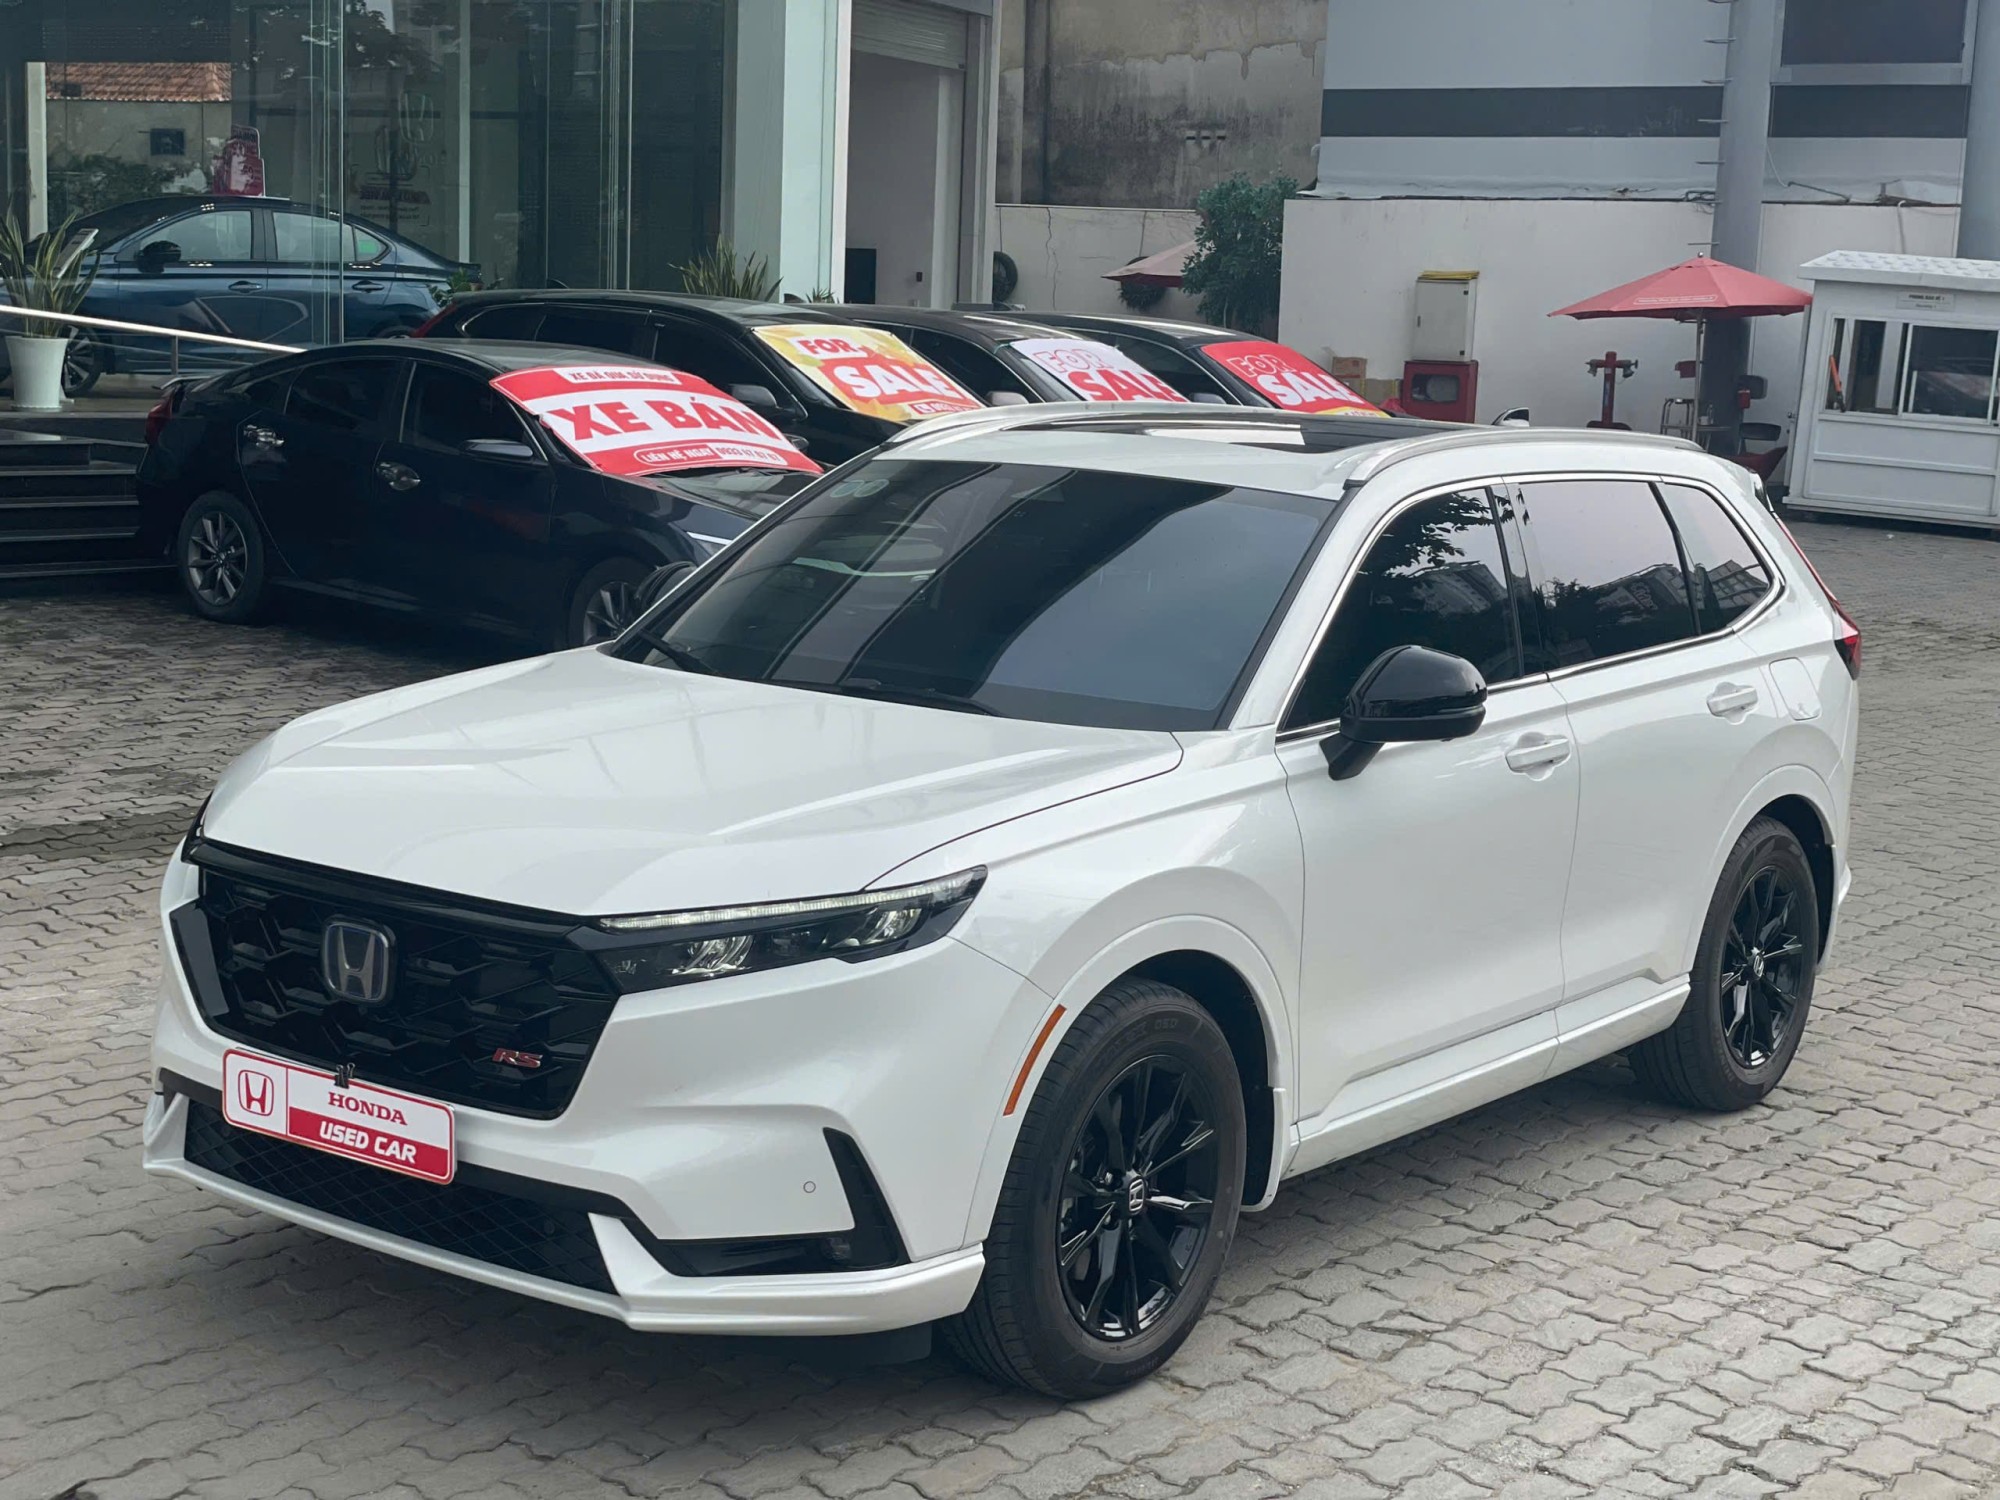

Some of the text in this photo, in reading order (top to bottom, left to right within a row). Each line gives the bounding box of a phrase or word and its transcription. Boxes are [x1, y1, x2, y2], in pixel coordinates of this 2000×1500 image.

[798, 338, 857, 355] FOR
[1033, 349, 1114, 373] FOR
[834, 364, 959, 398] SALE
[1226, 354, 1297, 378] FOR
[1068, 369, 1190, 402] SALE
[1257, 372, 1365, 406] SALE
[546, 396, 782, 441] XE BÁN
[492, 1048, 543, 1068] RS
[328, 1092, 408, 1126] HONDA
[319, 1121, 417, 1164] USED CAR
